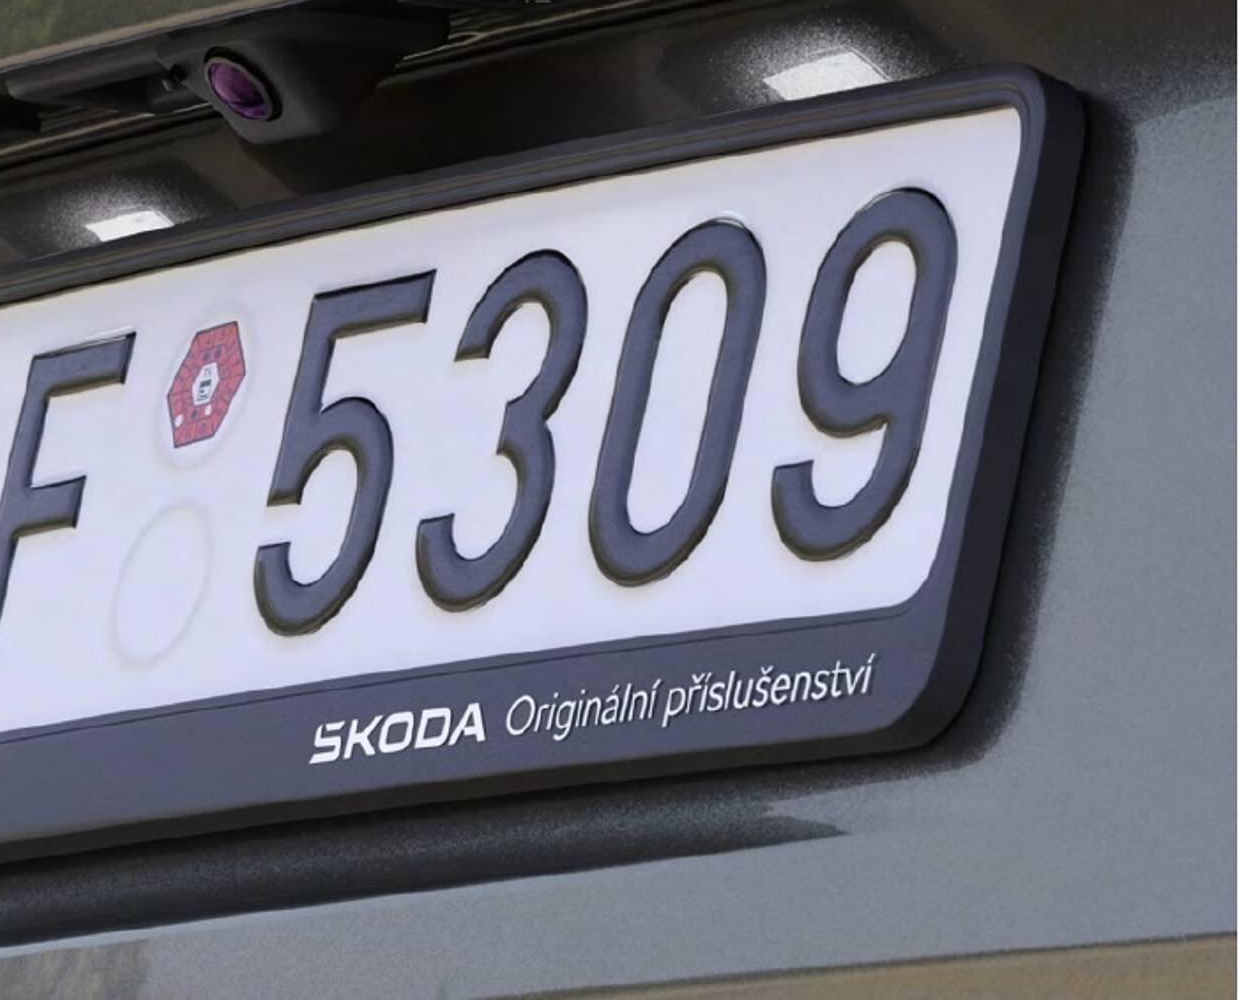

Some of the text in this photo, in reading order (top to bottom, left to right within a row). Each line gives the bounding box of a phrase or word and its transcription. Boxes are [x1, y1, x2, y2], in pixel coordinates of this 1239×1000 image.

[252, 186, 958, 636] 5309
[504, 679, 662, 741] Originální
[662, 653, 875, 726] příslušenství
